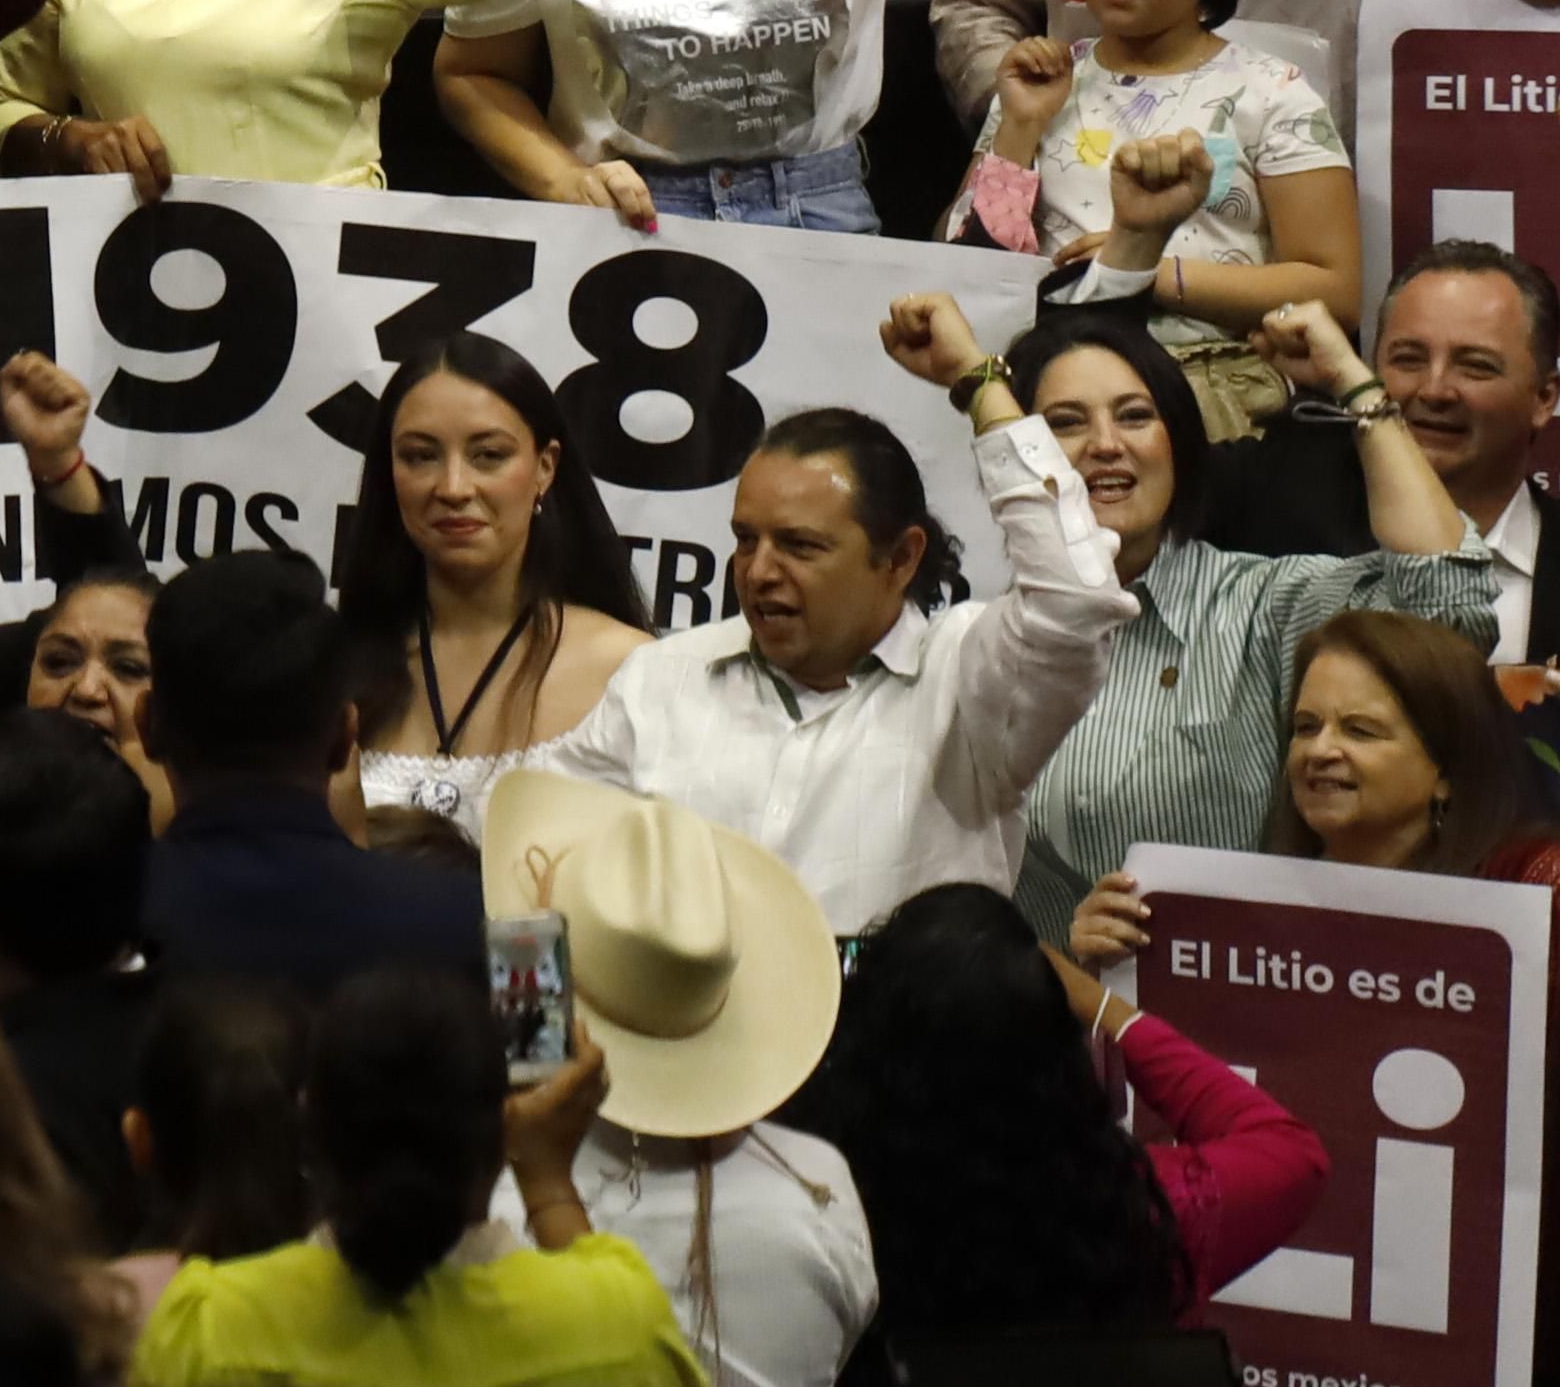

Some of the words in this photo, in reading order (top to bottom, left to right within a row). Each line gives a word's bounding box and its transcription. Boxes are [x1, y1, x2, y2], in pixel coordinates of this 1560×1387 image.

[664, 35, 702, 61] TO
[711, 15, 832, 55] HAPPEN
[1424, 73, 1468, 111] El
[1483, 73, 1560, 113] Liti
[1171, 938, 1212, 980] El
[1228, 946, 1335, 994] Litio
[1348, 968, 1401, 1004] es
[1415, 969, 1476, 1013] de
